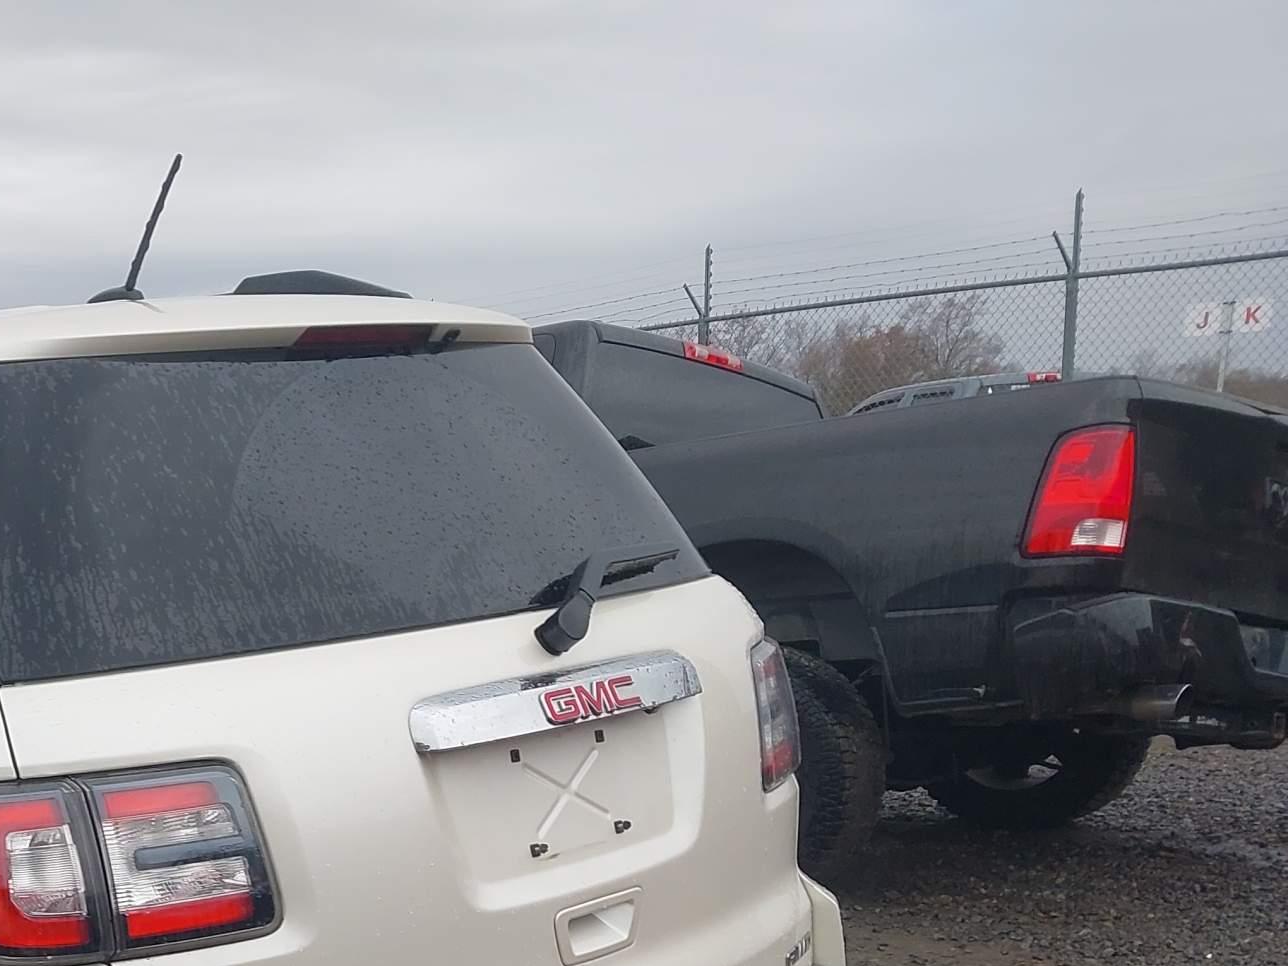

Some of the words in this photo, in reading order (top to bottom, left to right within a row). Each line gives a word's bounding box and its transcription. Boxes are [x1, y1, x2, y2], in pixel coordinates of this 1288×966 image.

[1195, 311, 1210, 330] J
[1243, 304, 1262, 325] K
[540, 675, 643, 726] GMC
